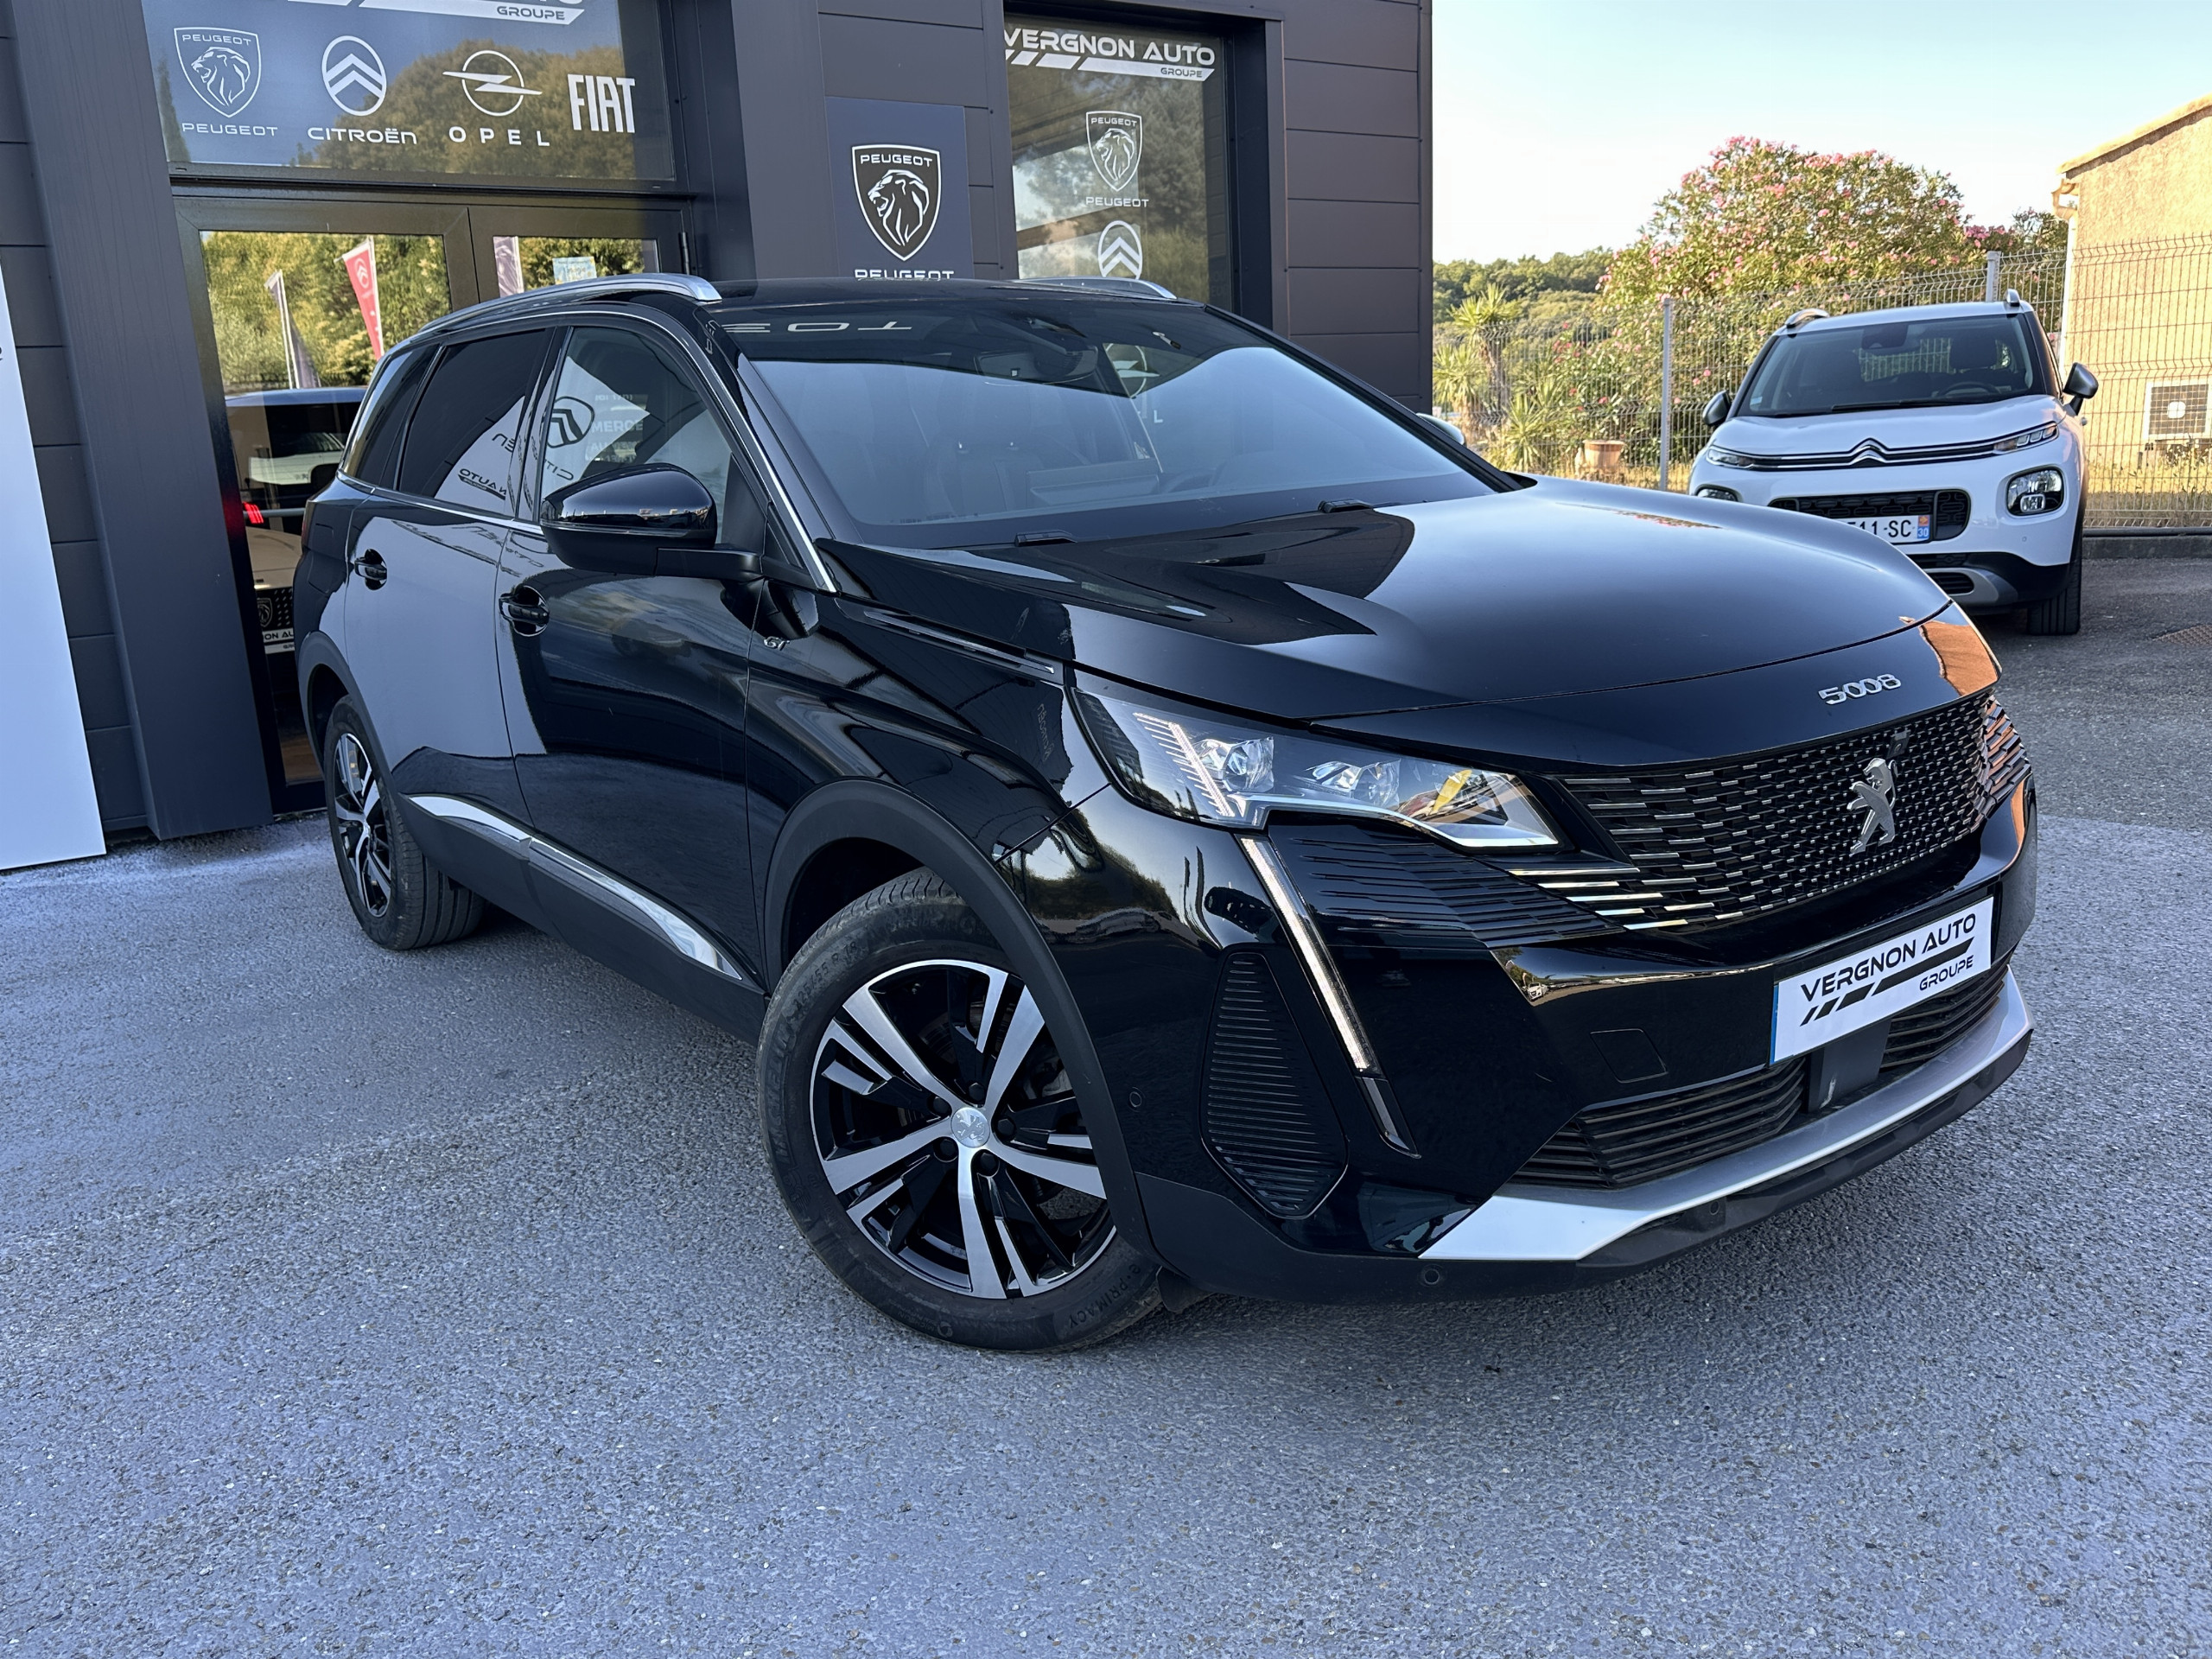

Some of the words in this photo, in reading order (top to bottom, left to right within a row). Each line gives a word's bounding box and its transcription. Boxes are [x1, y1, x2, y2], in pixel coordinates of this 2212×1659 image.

[496, 6, 565, 20] GROUPE
[181, 35, 251, 46] PEUGEOT
[1004, 28, 1135, 58] VERGNON
[1142, 41, 1216, 66] AUTO
[1160, 67, 1203, 78] GROUPE
[567, 73, 635, 133] FIAT
[1090, 117, 1138, 127] PEUGEOT
[181, 123, 278, 137] PEUGEOT
[307, 127, 416, 144] CITROËN
[448, 125, 550, 146] OPEL
[860, 154, 933, 168] PEUGEOT
[1085, 196, 1150, 208] PEUGEOT
[1917, 527, 1929, 537] 30
[1818, 673, 1901, 705] 5008
[1800, 938, 1916, 1002] VERGNON
[1922, 912, 1976, 954] AUTO
[1919, 955, 1974, 992] GROUPE
